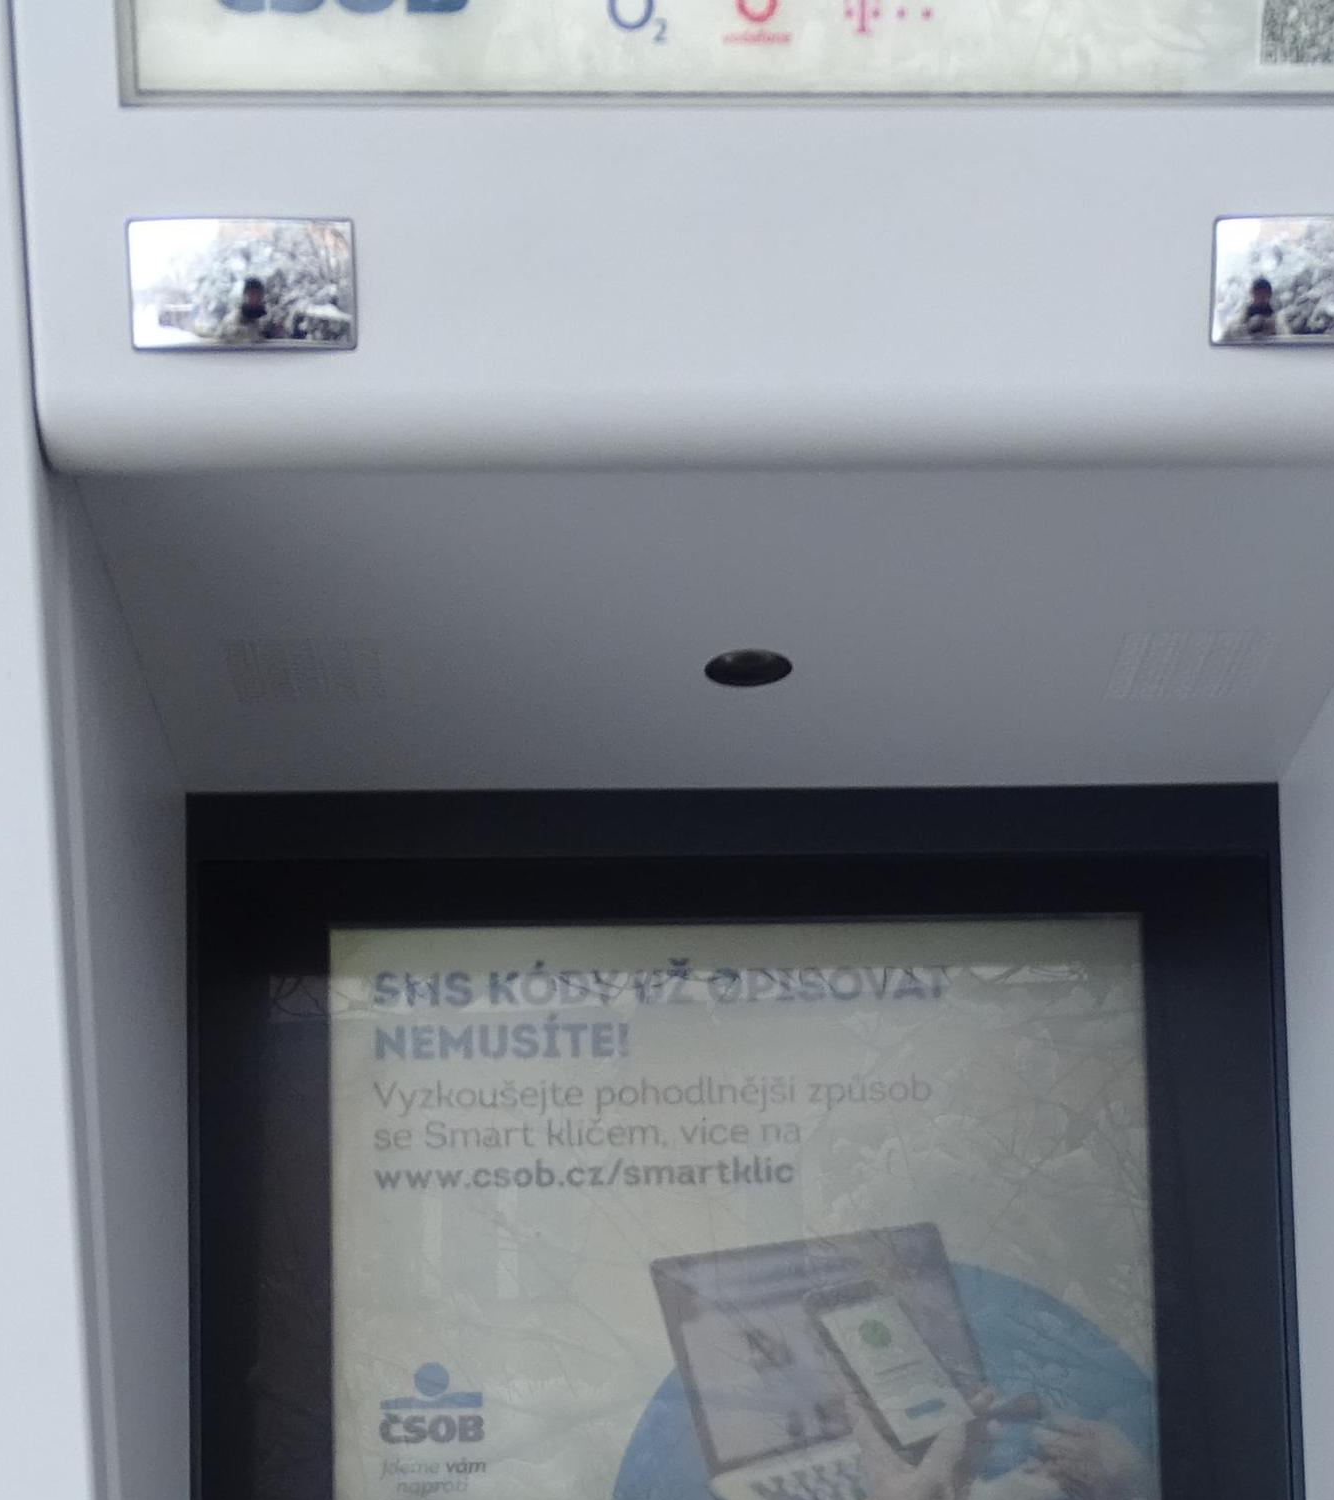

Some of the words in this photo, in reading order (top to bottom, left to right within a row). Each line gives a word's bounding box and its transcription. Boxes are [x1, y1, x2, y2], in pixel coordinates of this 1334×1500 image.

[373, 970, 474, 1006] SMS
[488, 959, 622, 1005] KÓDY
[706, 965, 949, 1003] OPISOVAT
[374, 1014, 630, 1060] NEMUSÍTE!
[373, 1079, 584, 1116] Vyzkoušejte
[595, 1076, 796, 1115] pohodlnější
[808, 1074, 932, 1112] způsob
[374, 1128, 412, 1151] se
[424, 1120, 536, 1150] Smart
[761, 1122, 801, 1144] na
[374, 1157, 796, 1190] www.csob.cz/smartklic
[378, 1412, 485, 1444] ČSOB
[445, 1456, 487, 1474] vám
